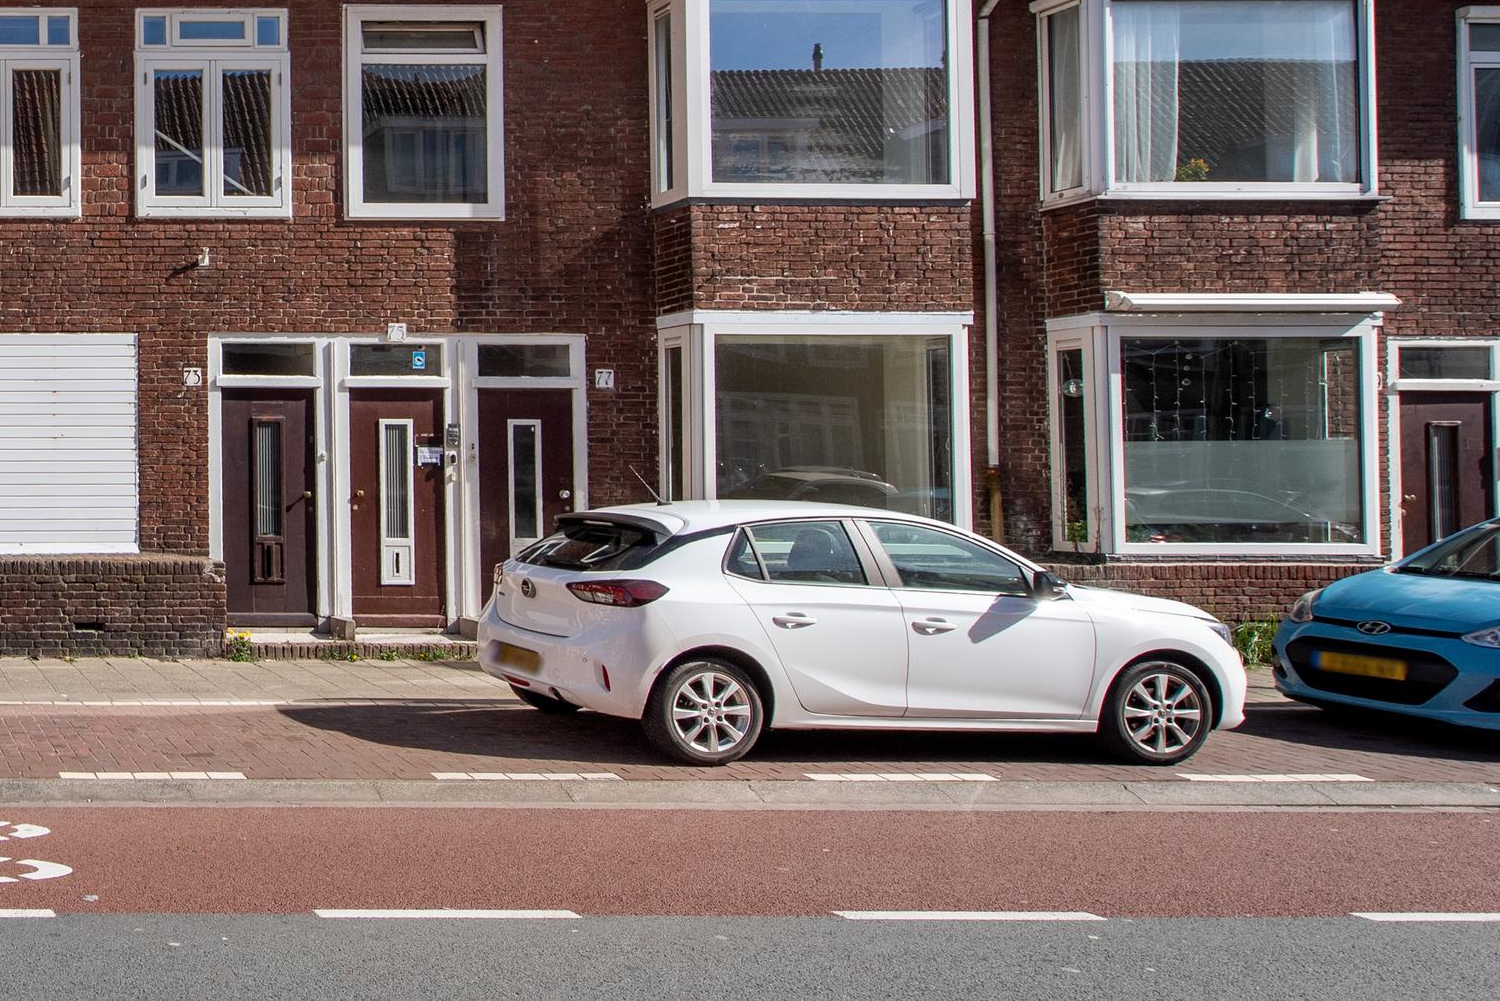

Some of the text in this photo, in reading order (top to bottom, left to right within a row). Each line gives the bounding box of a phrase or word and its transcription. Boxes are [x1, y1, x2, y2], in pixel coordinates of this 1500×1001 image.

[389, 325, 404, 340] 75
[184, 370, 200, 385] 73
[597, 371, 612, 385] 77
